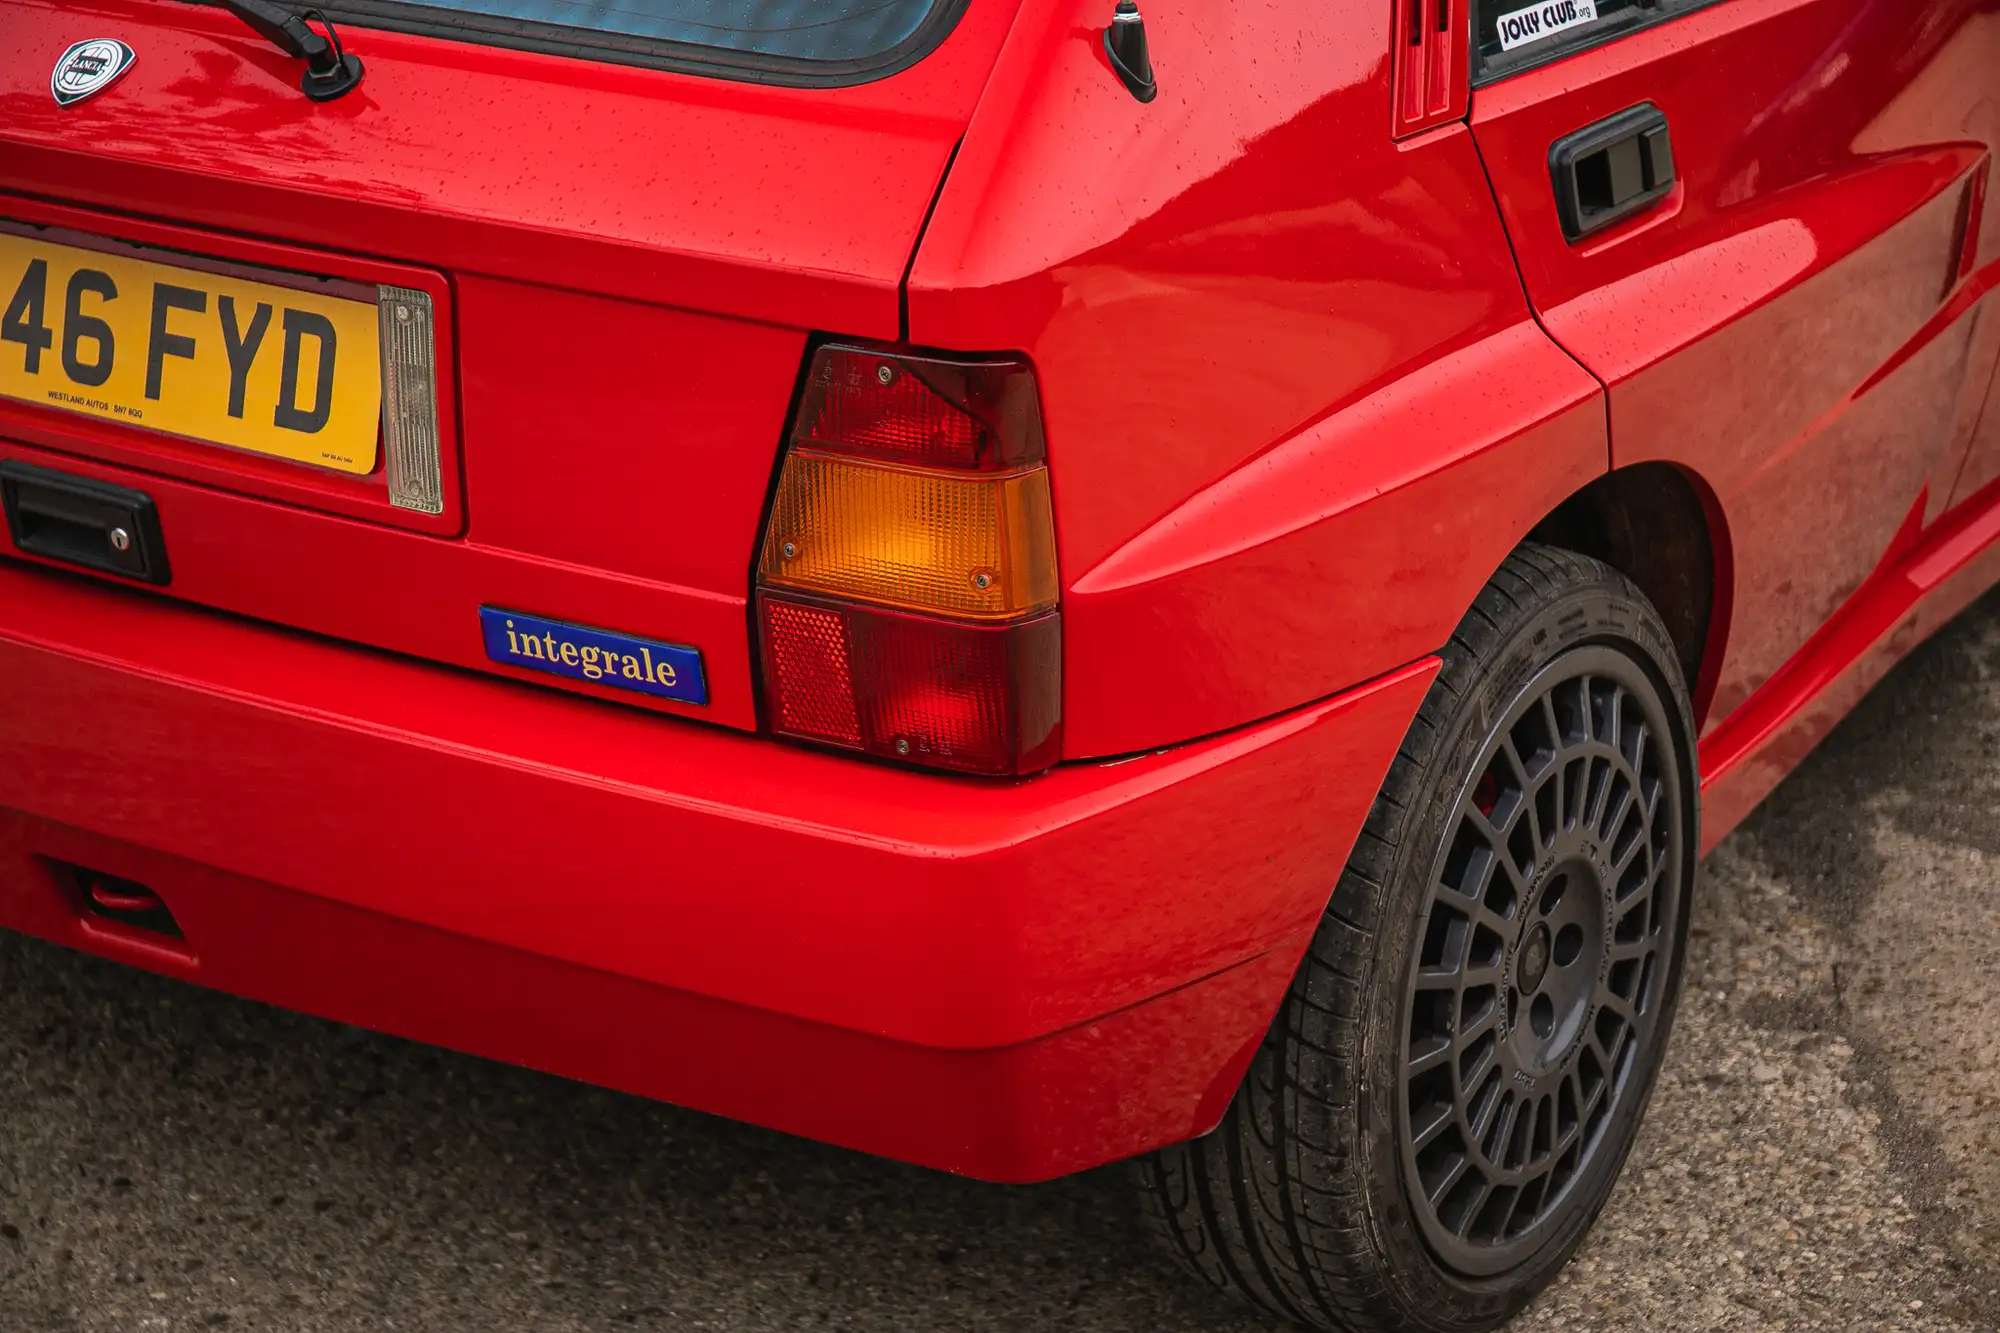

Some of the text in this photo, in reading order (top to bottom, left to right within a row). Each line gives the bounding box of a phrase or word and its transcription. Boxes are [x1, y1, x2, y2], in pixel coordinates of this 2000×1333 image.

[1501, 11, 1540, 43] JOLLY
[1543, 0, 1577, 28] CLUB
[1, 258, 337, 434] 46 FYD
[48, 390, 85, 405] WESTLAND
[86, 398, 109, 410] AUTOS
[506, 619, 677, 687] integrale
